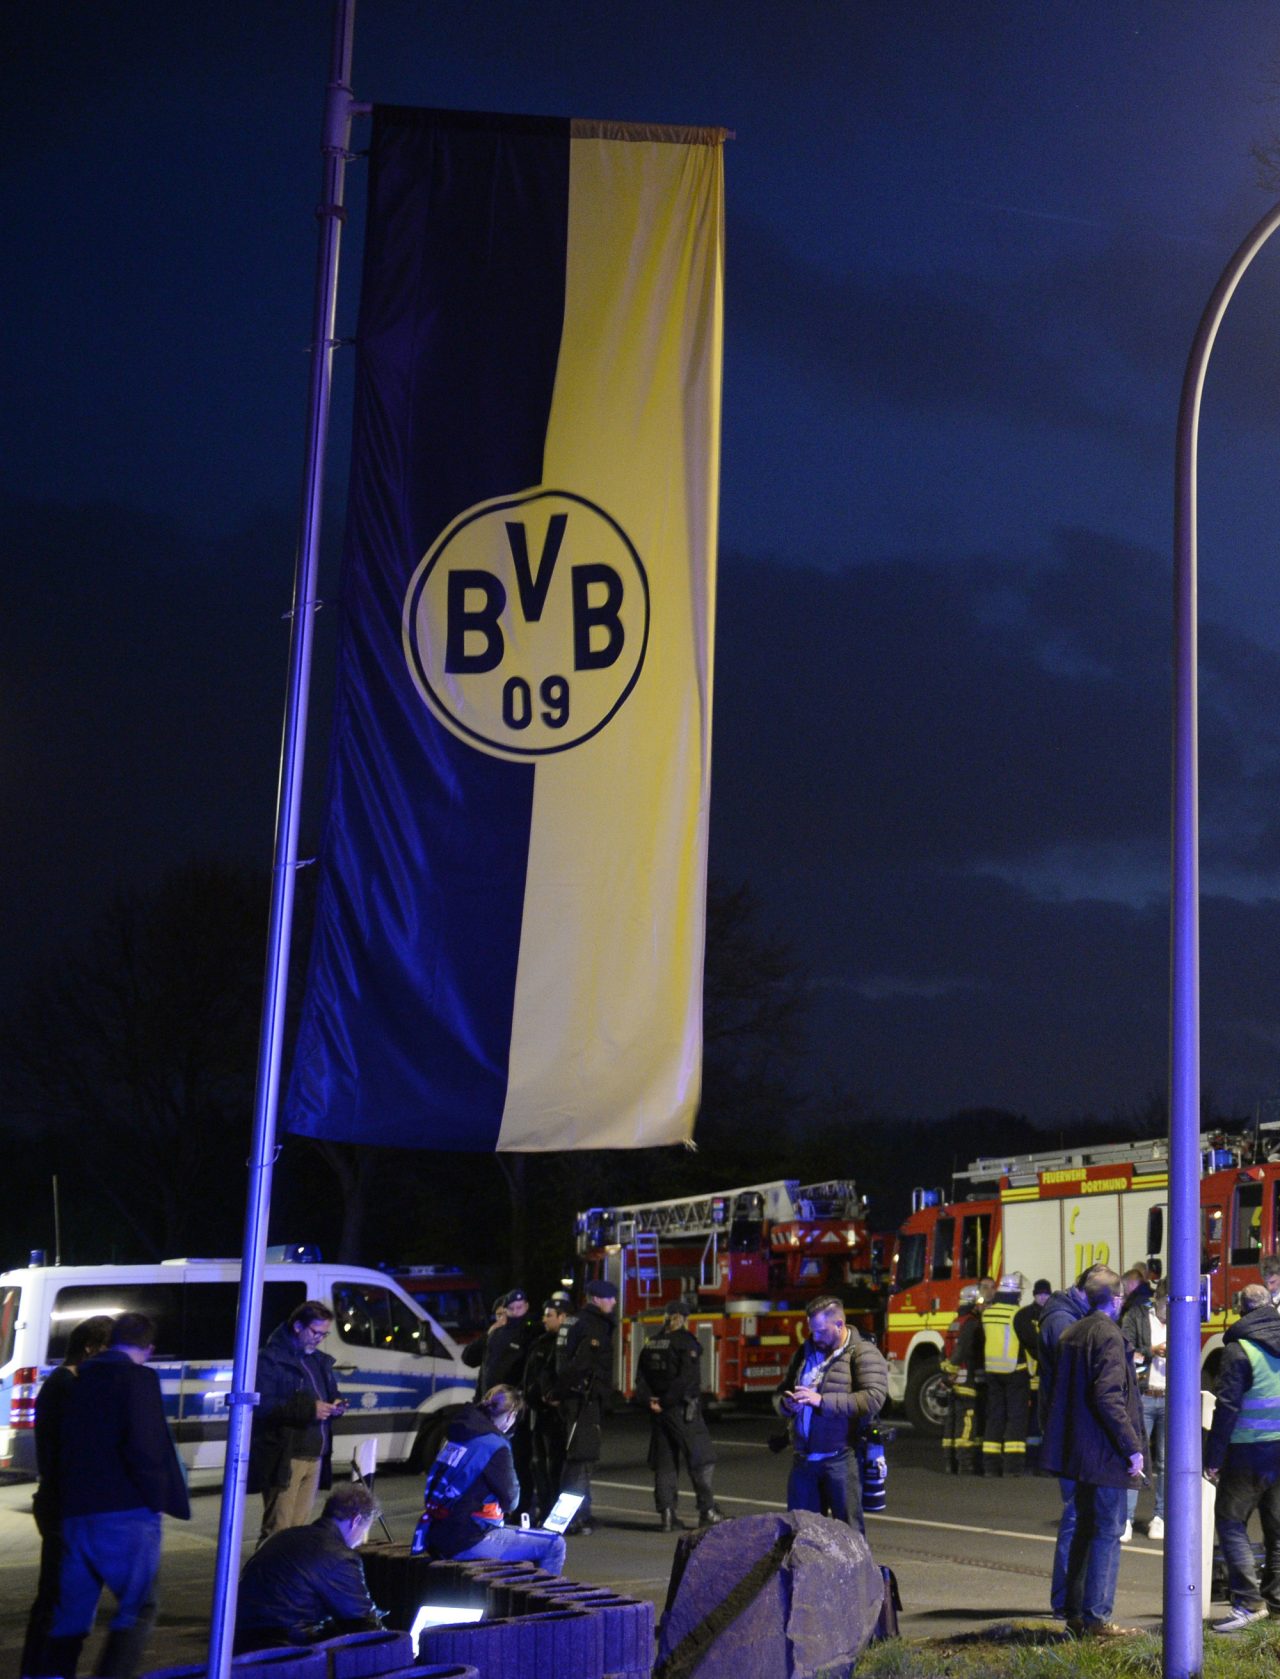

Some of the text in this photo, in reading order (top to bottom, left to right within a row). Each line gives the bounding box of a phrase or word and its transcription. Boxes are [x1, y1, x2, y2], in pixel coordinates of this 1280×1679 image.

[445, 513, 625, 674] BVB
[502, 675, 570, 730] 09
[1042, 1168, 1087, 1184] FEUERWEHR
[1081, 1177, 1128, 1194] DORTMUND
